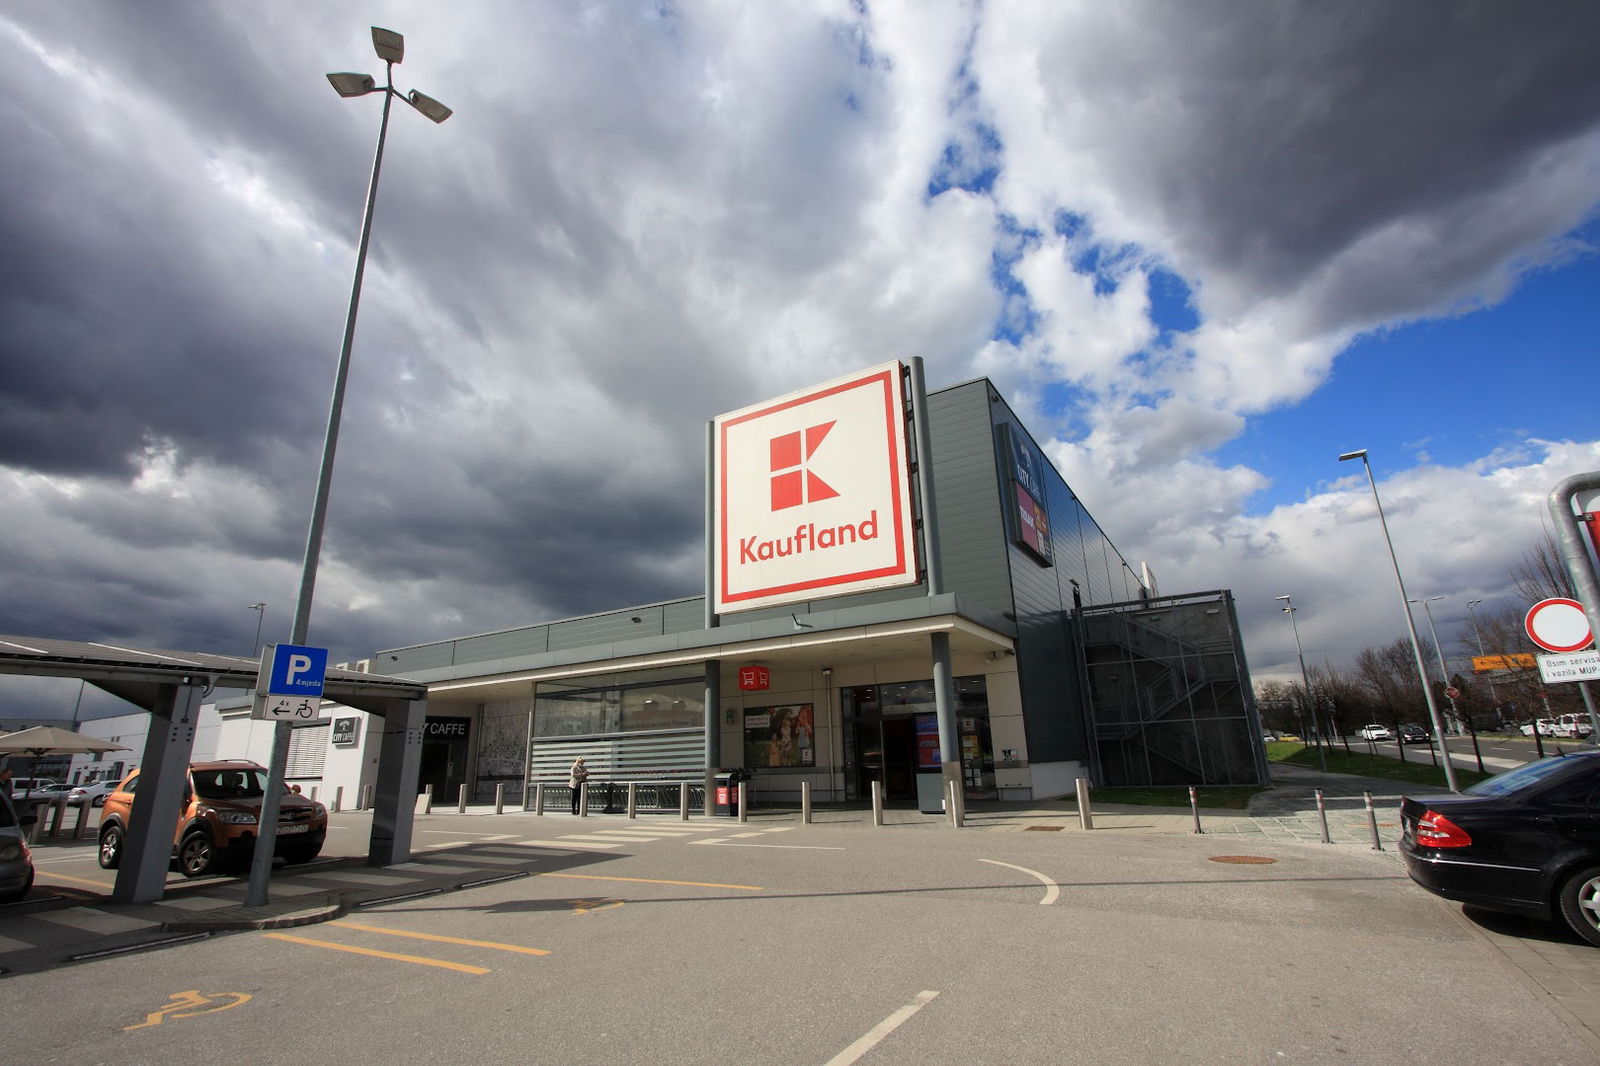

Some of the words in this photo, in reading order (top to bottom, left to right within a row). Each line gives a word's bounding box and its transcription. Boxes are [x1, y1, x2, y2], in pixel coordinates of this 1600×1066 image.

[740, 509, 879, 565] Kaufland
[1546, 659, 1566, 667] Osim
[286, 654, 312, 685] P
[1551, 669, 1576, 677] vozila
[300, 679, 321, 688] mjesta
[430, 722, 465, 735] CAFFE
